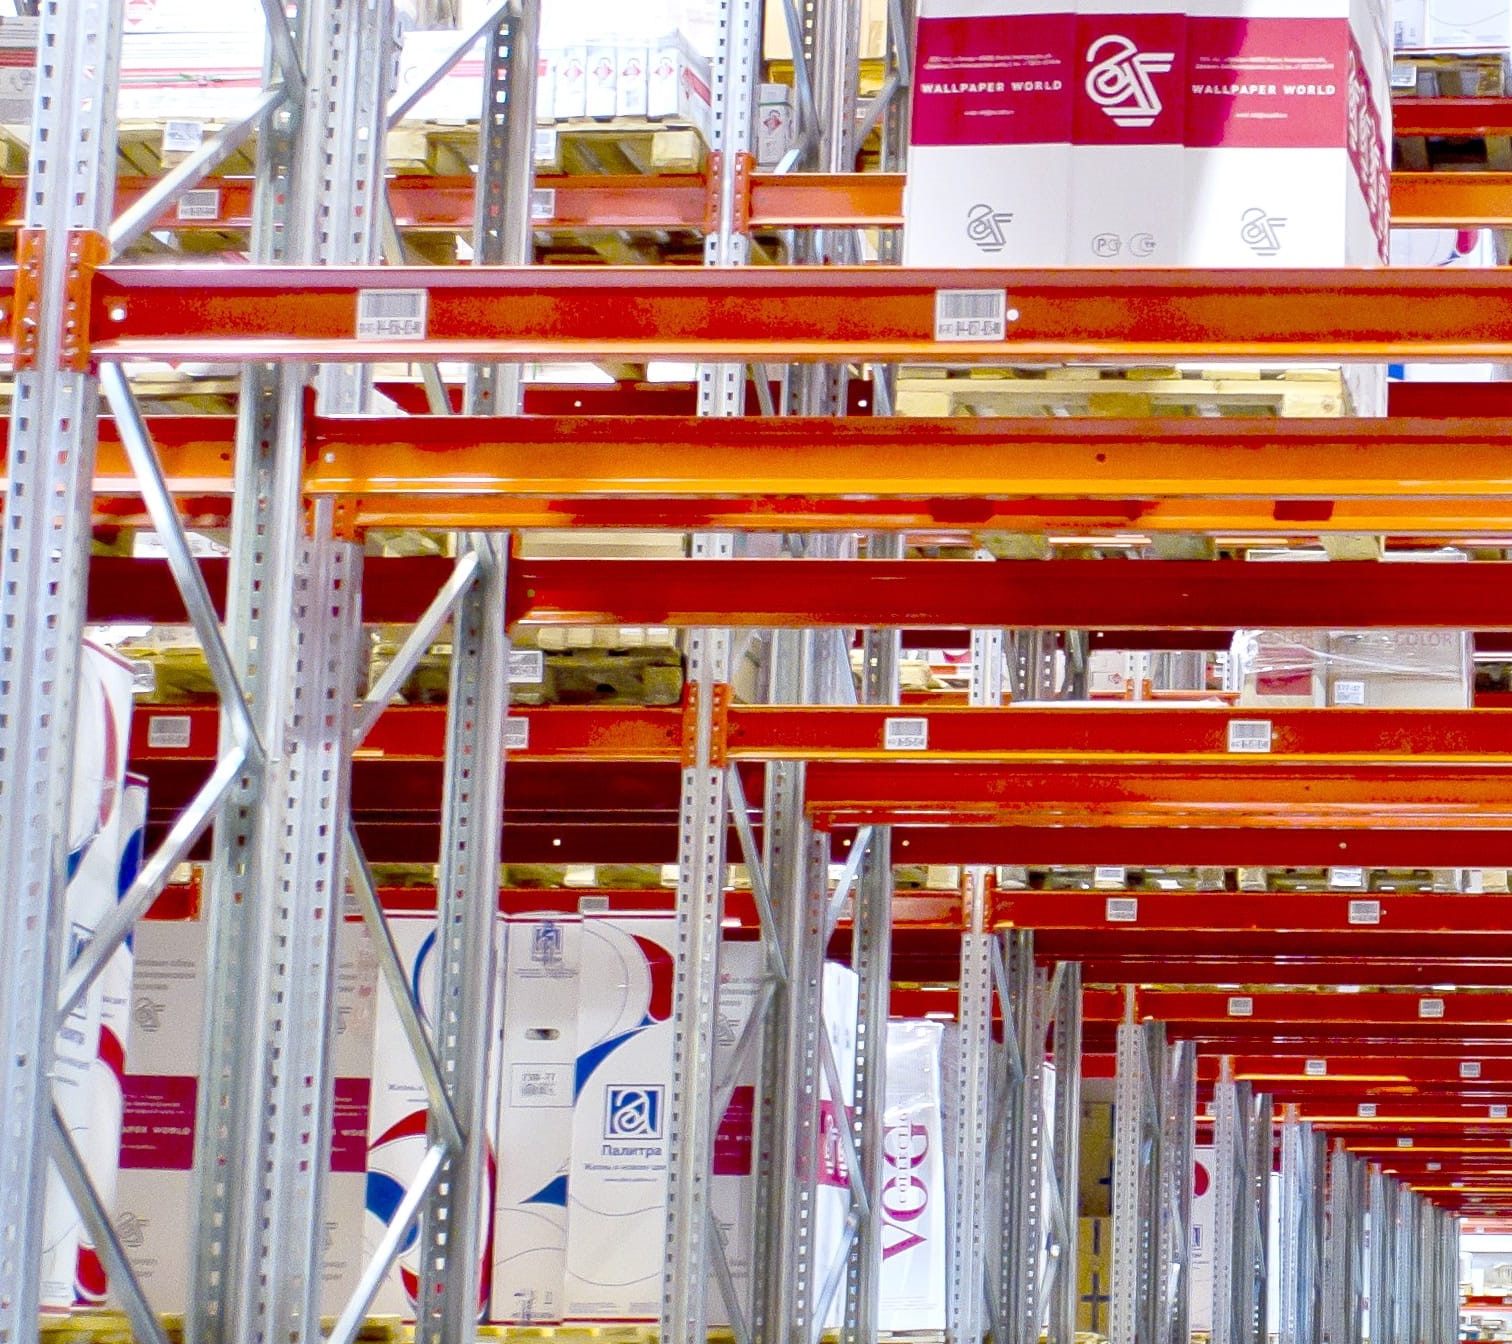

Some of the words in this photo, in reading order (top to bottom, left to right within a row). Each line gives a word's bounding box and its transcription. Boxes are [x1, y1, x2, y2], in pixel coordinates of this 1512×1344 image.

[920, 81, 1005, 94] WALLPAPER
[1011, 79, 1063, 92] WORLD
[1191, 84, 1277, 96] WALLPAPER
[1282, 84, 1336, 96] WORLD
[602, 1144, 663, 1159] Палитра
[880, 1122, 930, 1262] VOG
